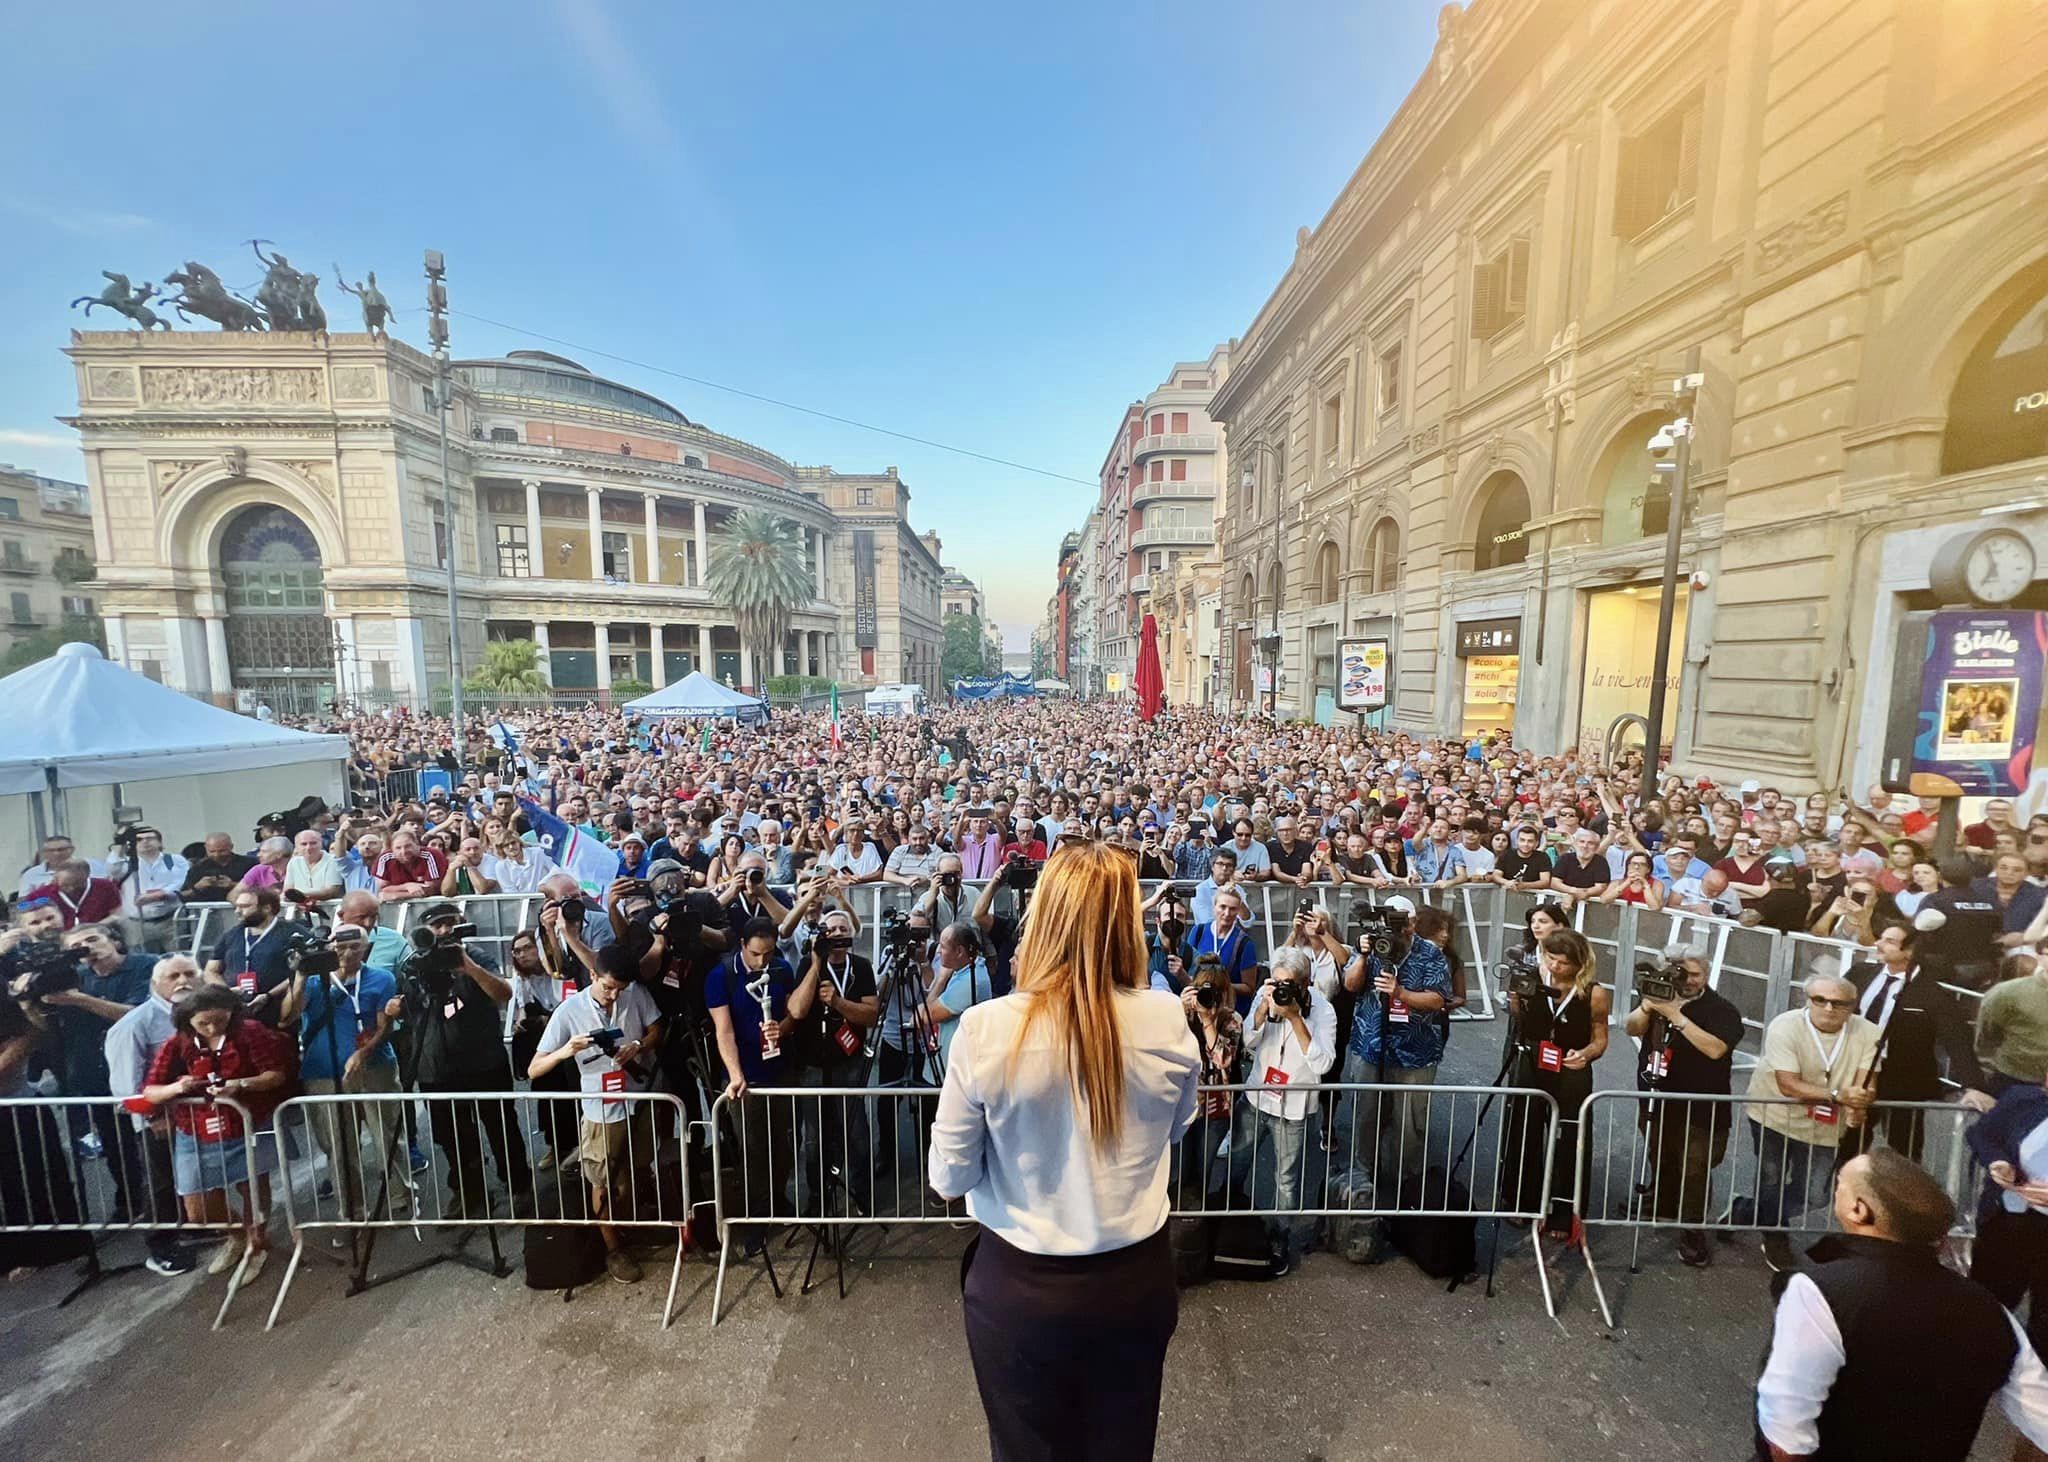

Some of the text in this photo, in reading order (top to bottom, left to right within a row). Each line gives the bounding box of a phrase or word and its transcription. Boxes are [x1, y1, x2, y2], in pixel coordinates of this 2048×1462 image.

[2014, 391, 2048, 413] PO
[1591, 667, 1604, 687] la
[644, 708, 715, 716] ORGANIZZAZIONE
